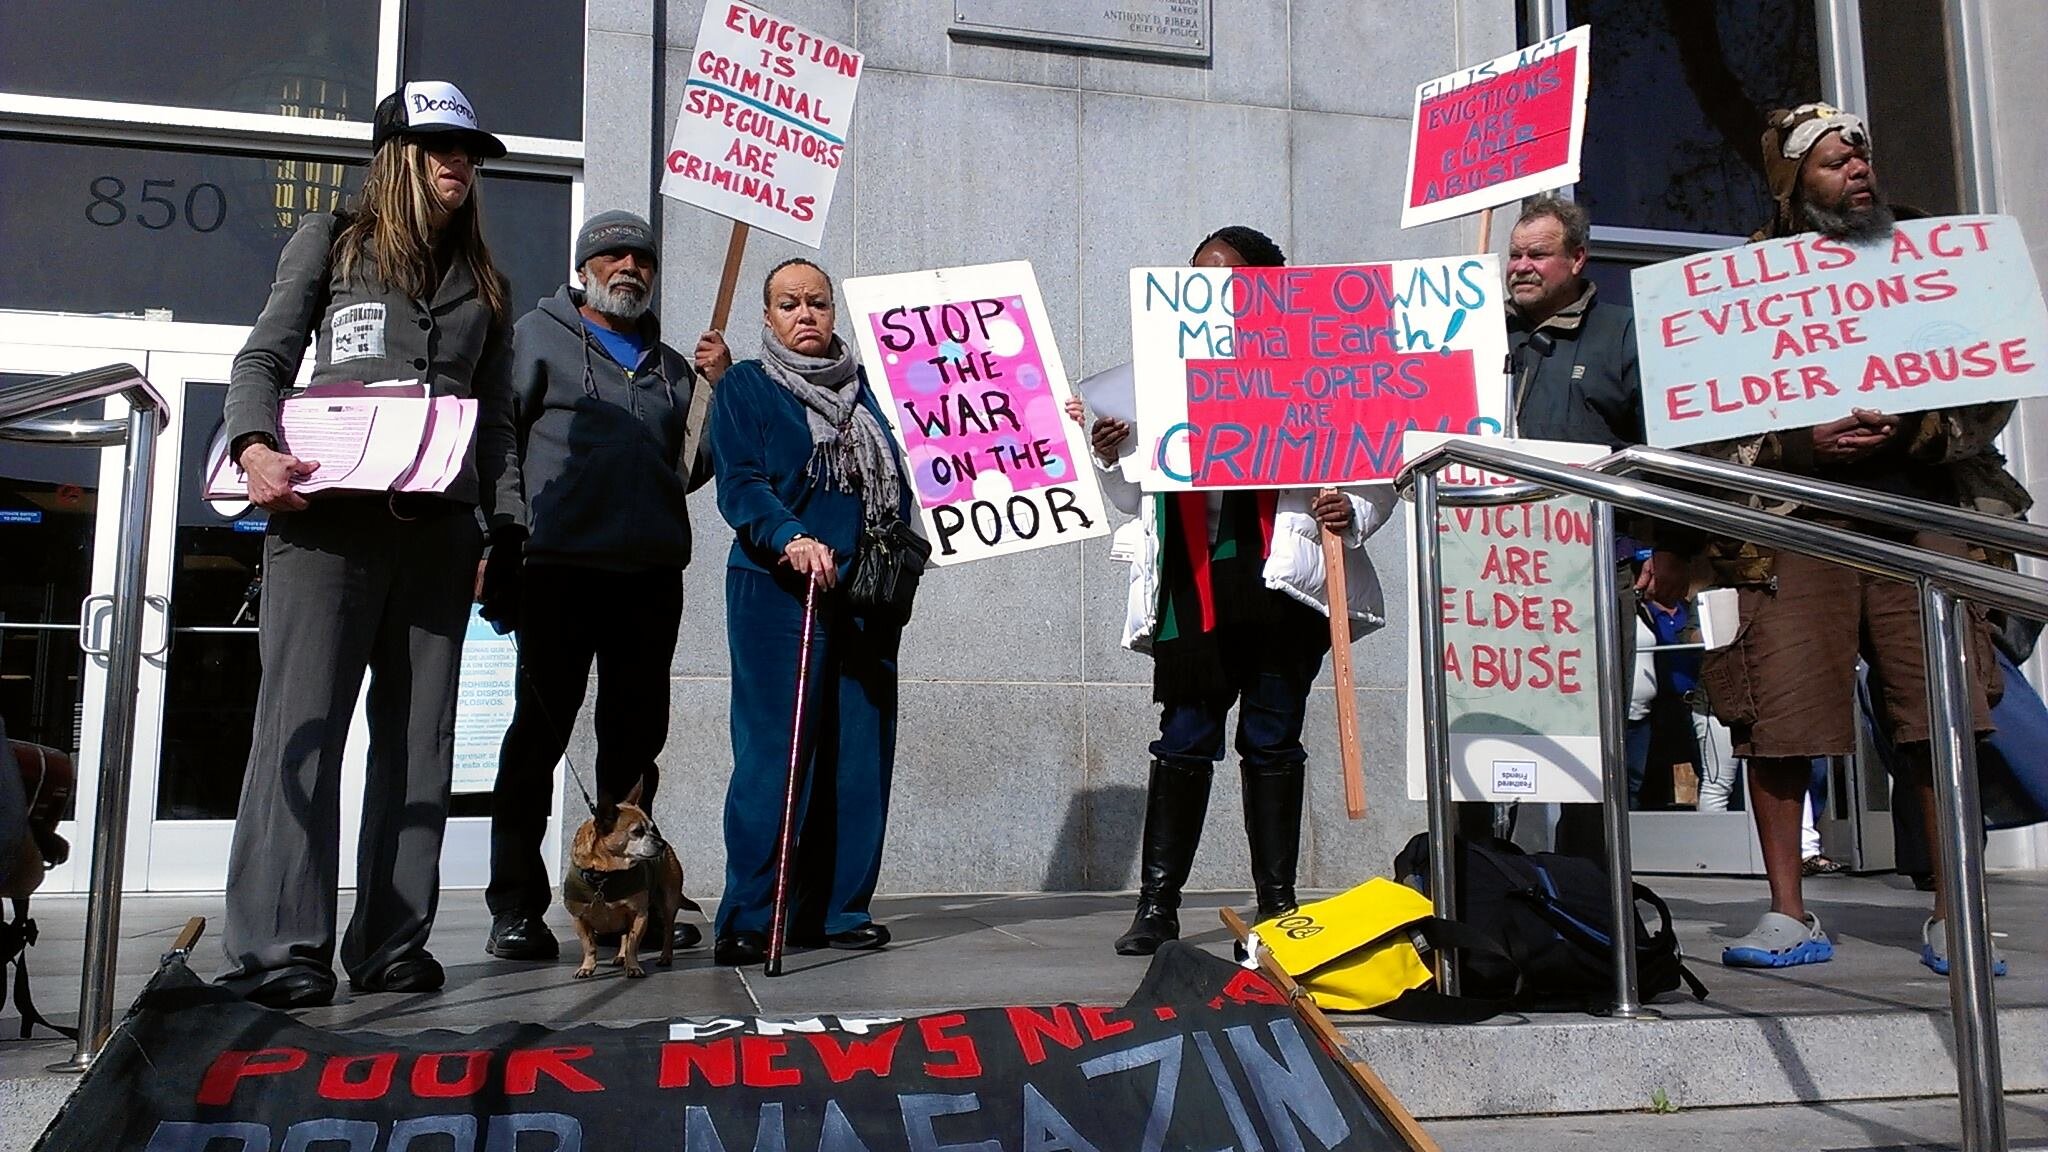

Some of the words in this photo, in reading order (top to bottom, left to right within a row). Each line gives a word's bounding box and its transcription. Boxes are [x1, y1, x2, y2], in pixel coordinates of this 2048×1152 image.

[1103, 10, 1151, 23] ANTHONY
[1165, 17, 1198, 28] RIBERA
[1129, 24, 1153, 32] CHIEF
[1156, 26, 1167, 34] OF
[1170, 29, 1198, 37] POLICE
[1171, 5, 1198, 15] MAYOR
[725, 4, 860, 78] EVICTION
[760, 50, 796, 77] IS
[698, 51, 831, 124] CRIMINAL
[1421, 61, 1500, 105] ELLIS
[1514, 35, 1566, 77] ACT
[1428, 66, 1561, 130] EVICTIONS
[685, 89, 844, 169] SPECULATORS
[1442, 125, 1538, 173] ELDER
[1466, 109, 1516, 145] ARE
[724, 138, 777, 178] ARE
[1422, 154, 1529, 205] ABUSE
[84, 176, 227, 233] 850
[667, 150, 815, 221] CRIMINALS
[1683, 235, 1857, 297] ELLIS
[1891, 221, 1993, 264] ACT
[1146, 271, 1213, 314] NO
[1221, 272, 1313, 318] ONE
[1333, 261, 1486, 315] OWNS
[1661, 268, 1958, 347] EVICTIONS
[358, 344, 369, 352] US
[881, 299, 1004, 352] STOP
[1179, 320, 1290, 359] Mama
[1310, 308, 1468, 358] Earth!
[1772, 317, 1868, 360] ARE
[928, 351, 1003, 384] THE
[1187, 358, 1429, 403] DEVIL-OPERS
[1666, 366, 1841, 421] ELDER
[1857, 338, 2036, 393] ABUSE
[904, 391, 1021, 437] WAR
[1284, 404, 1334, 428] ARE
[932, 452, 978, 486] ON
[986, 439, 1056, 474] THE
[1158, 416, 1501, 483] CRIMIN
[931, 488, 1094, 556] POOR
[1480, 545, 1552, 585] ARE
[1441, 587, 1580, 633] ELDER
[1443, 642, 1582, 693] ABUSE
[1498, 780, 1532, 788] Feathered
[1502, 772, 1528, 780] Friends
[197, 1044, 606, 1105] POOR
[659, 1014, 982, 1088] NEWS
